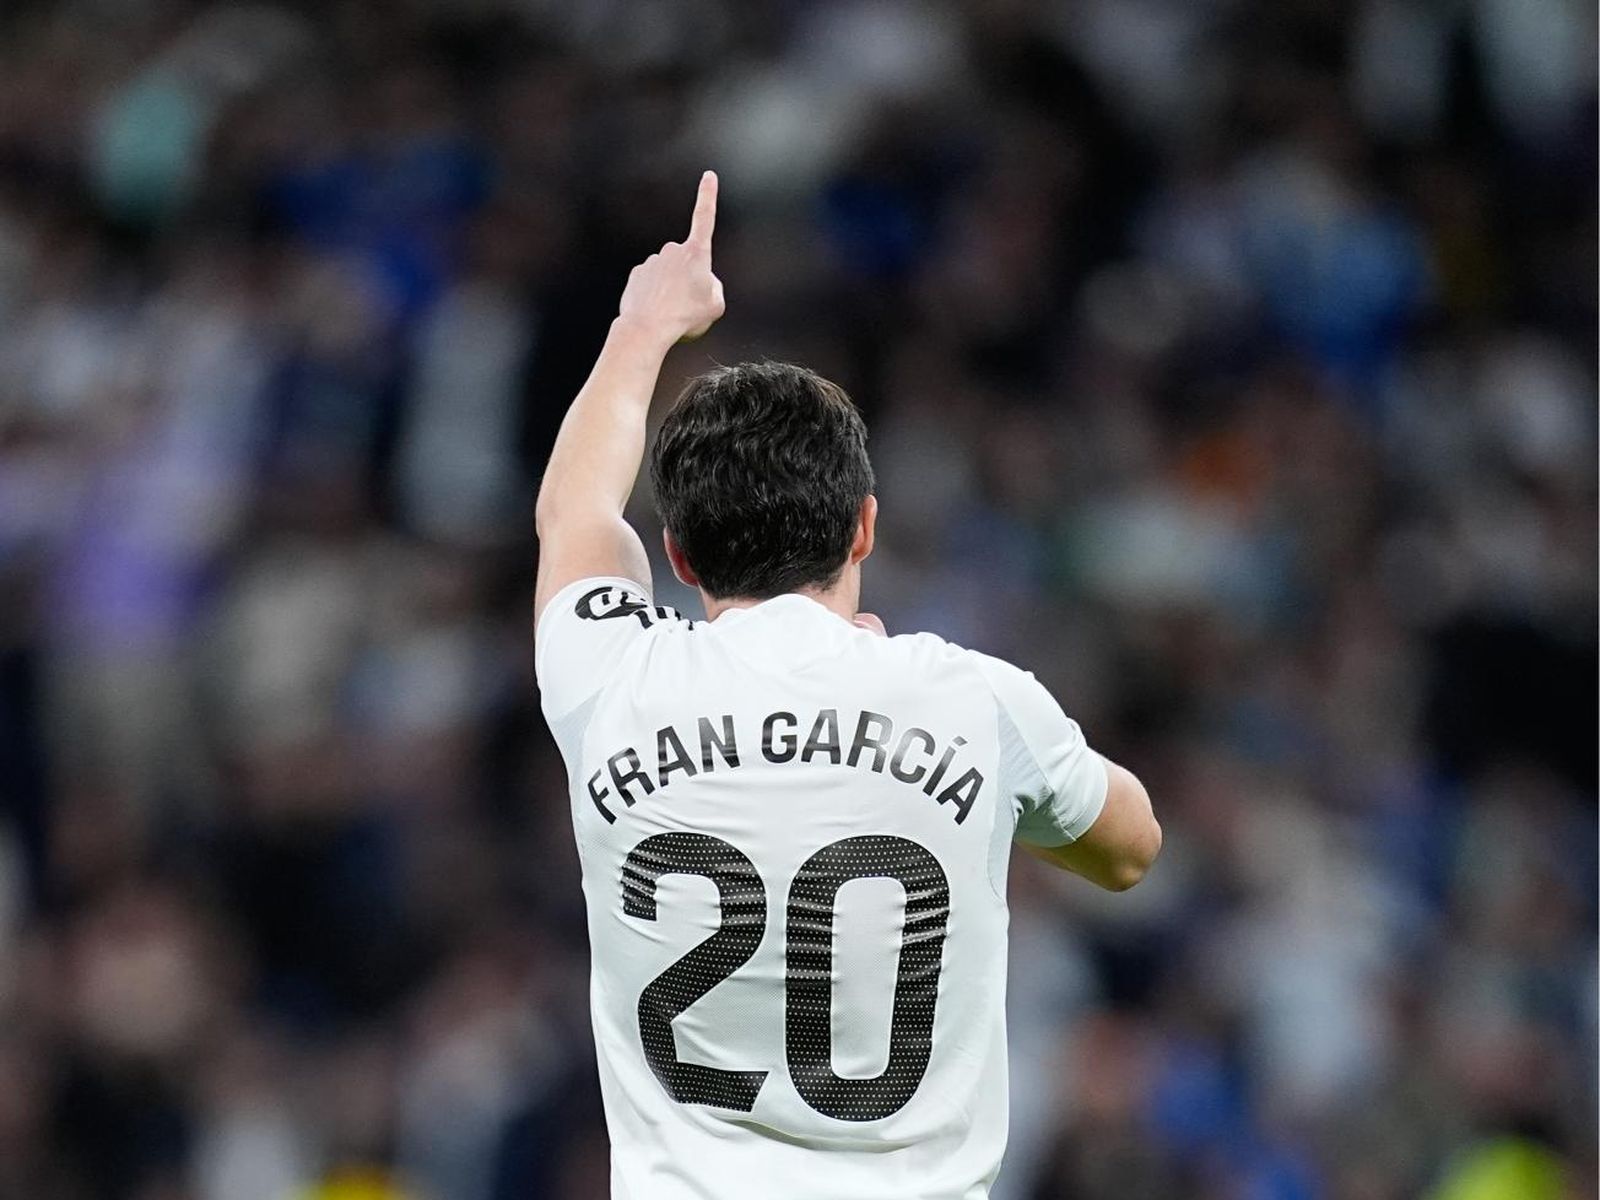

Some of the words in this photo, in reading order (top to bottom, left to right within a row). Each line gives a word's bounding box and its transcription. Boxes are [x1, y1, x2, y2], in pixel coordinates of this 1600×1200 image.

[587, 714, 741, 825] FRAN
[760, 708, 985, 826] GARCÍA
[620, 831, 951, 1122] 20
